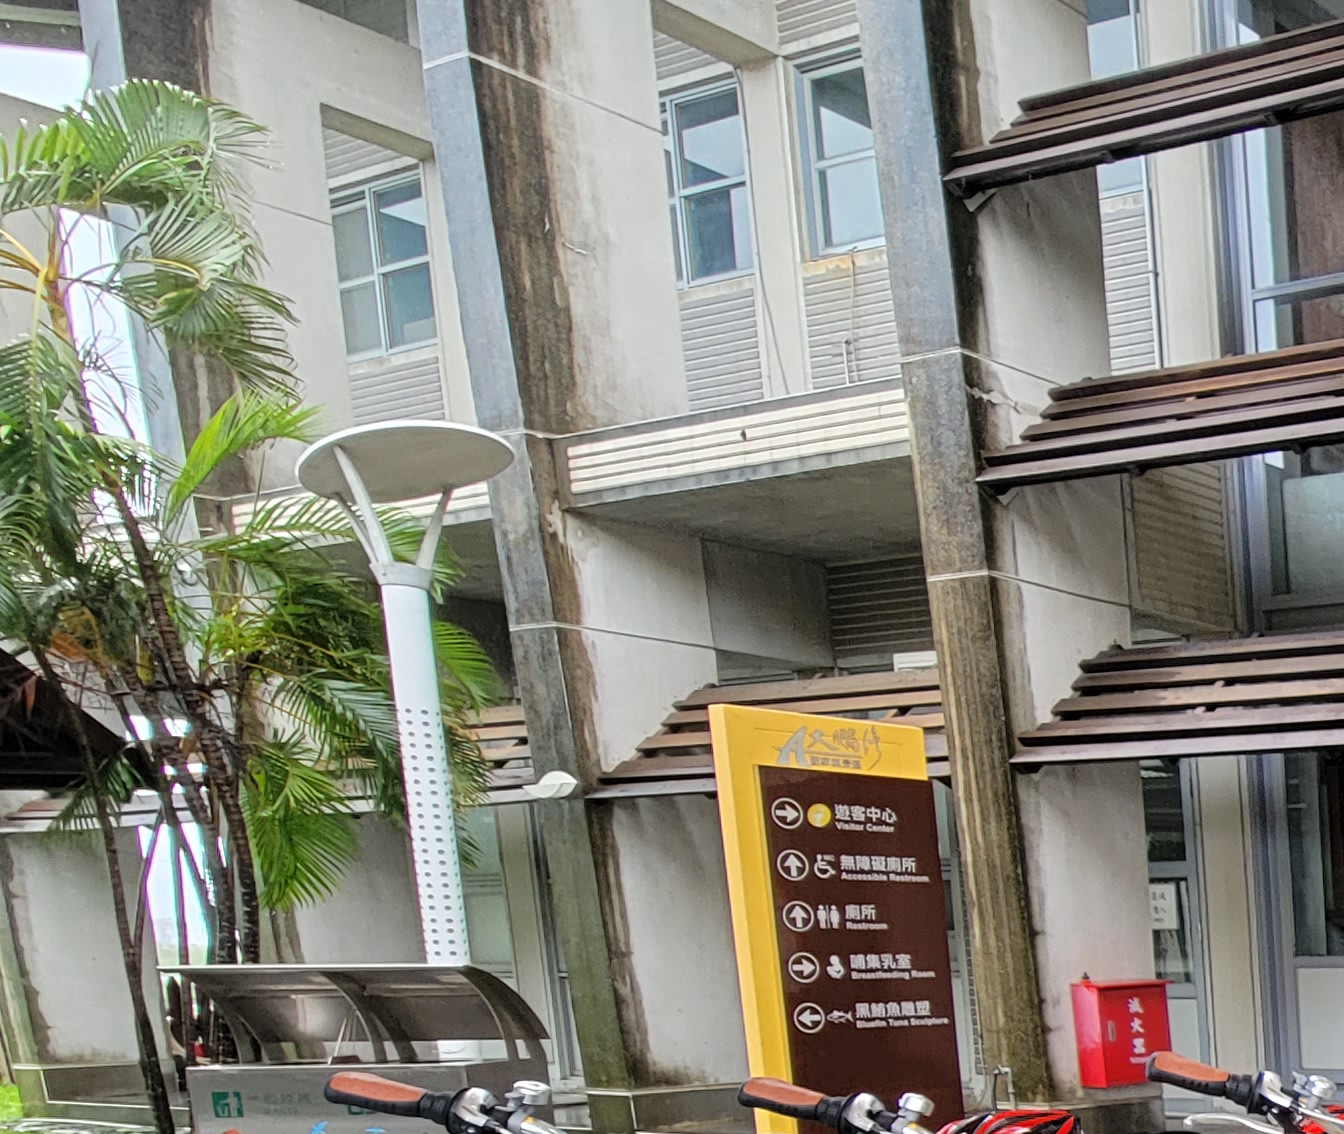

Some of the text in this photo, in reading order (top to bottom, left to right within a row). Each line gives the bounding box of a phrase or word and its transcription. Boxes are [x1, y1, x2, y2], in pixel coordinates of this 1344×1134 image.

[834, 803, 897, 823] 遊客中心
[835, 821, 895, 833] Visitor Center
[839, 855, 917, 873] 無障礙廁所
[840, 872, 930, 883] Accessible Restroom
[845, 904, 876, 920] 廁所
[846, 922, 888, 930] Restroom
[851, 970, 935, 981] Breastfeeding Room
[889, 1019, 909, 1027] Tuna
[910, 1017, 949, 1027] Sculpture
